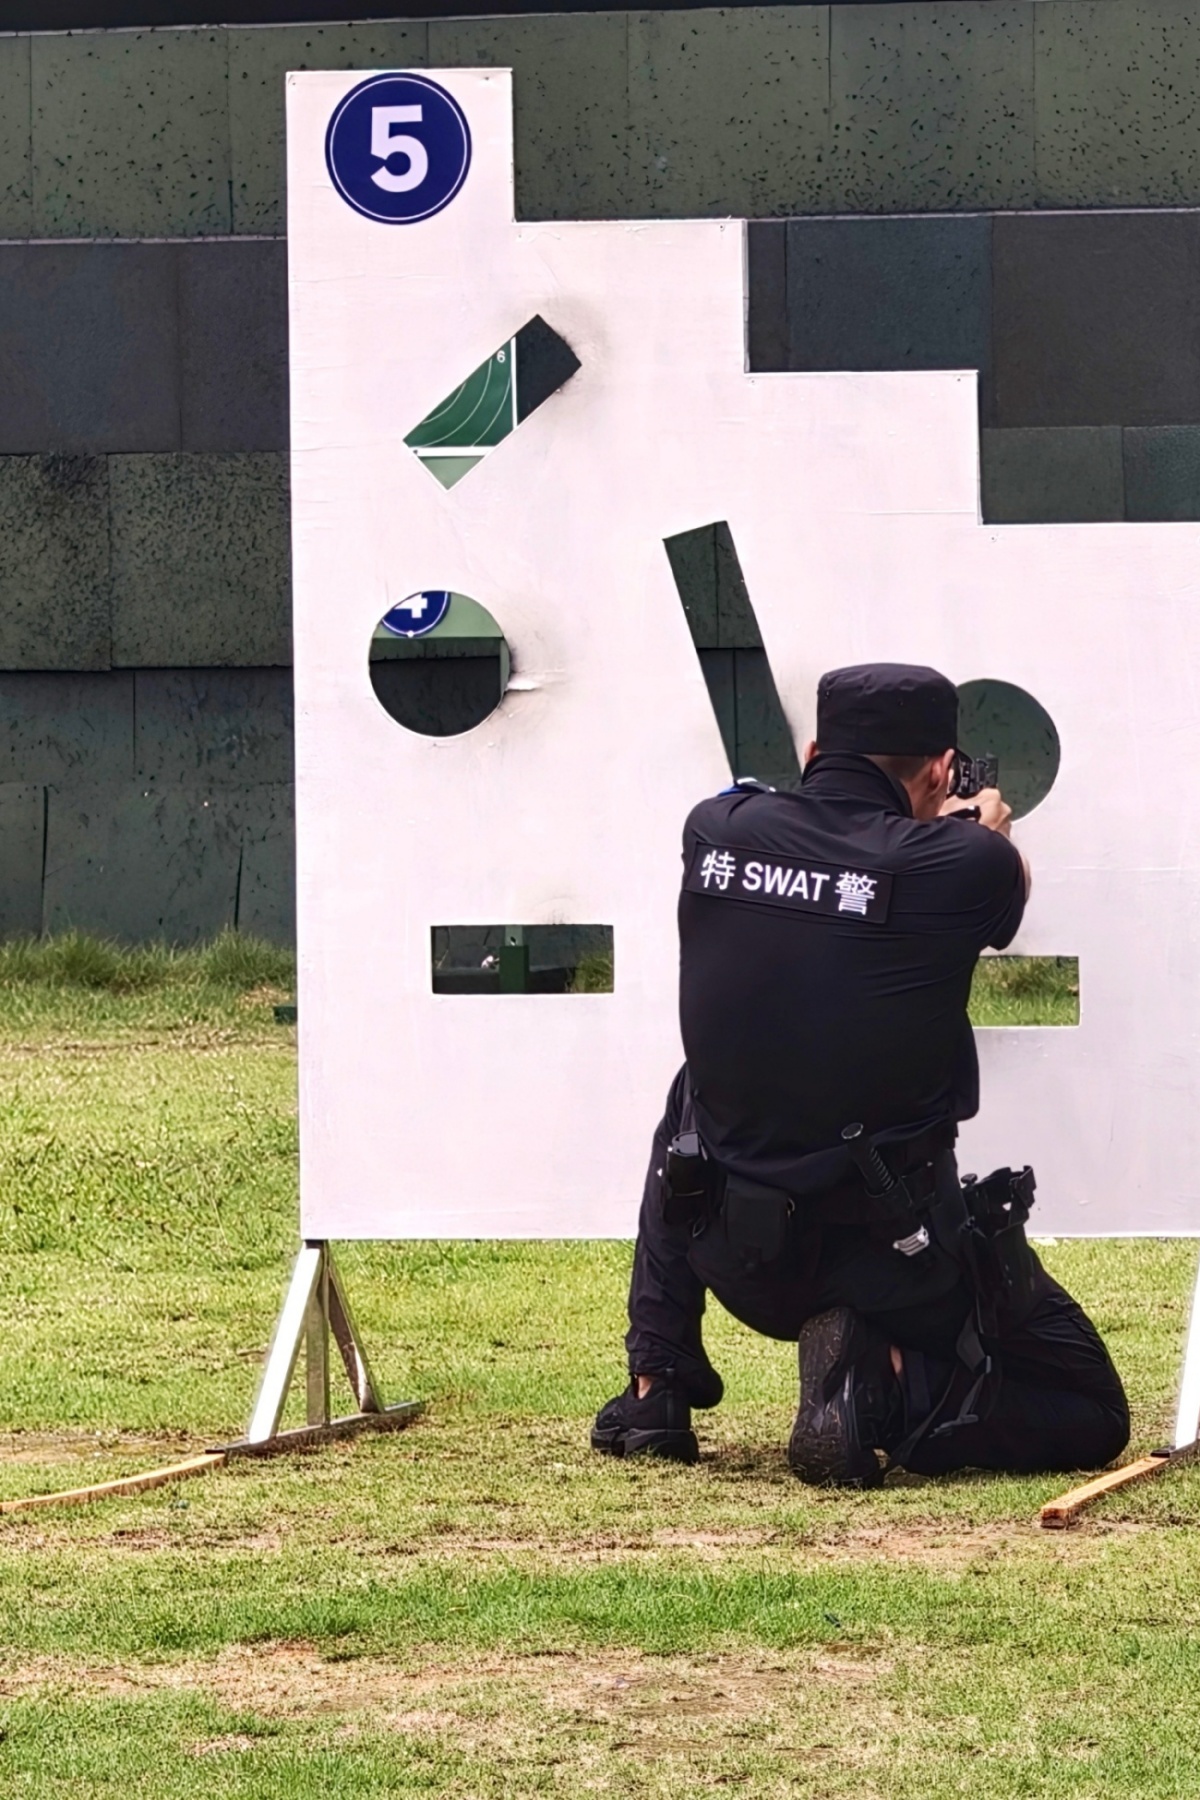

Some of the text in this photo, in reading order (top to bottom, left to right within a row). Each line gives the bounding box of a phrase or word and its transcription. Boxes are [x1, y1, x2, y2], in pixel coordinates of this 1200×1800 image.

[370, 103, 428, 193] 5
[496, 350, 506, 363] 6
[700, 849, 878, 915] 特 SWAT 警
